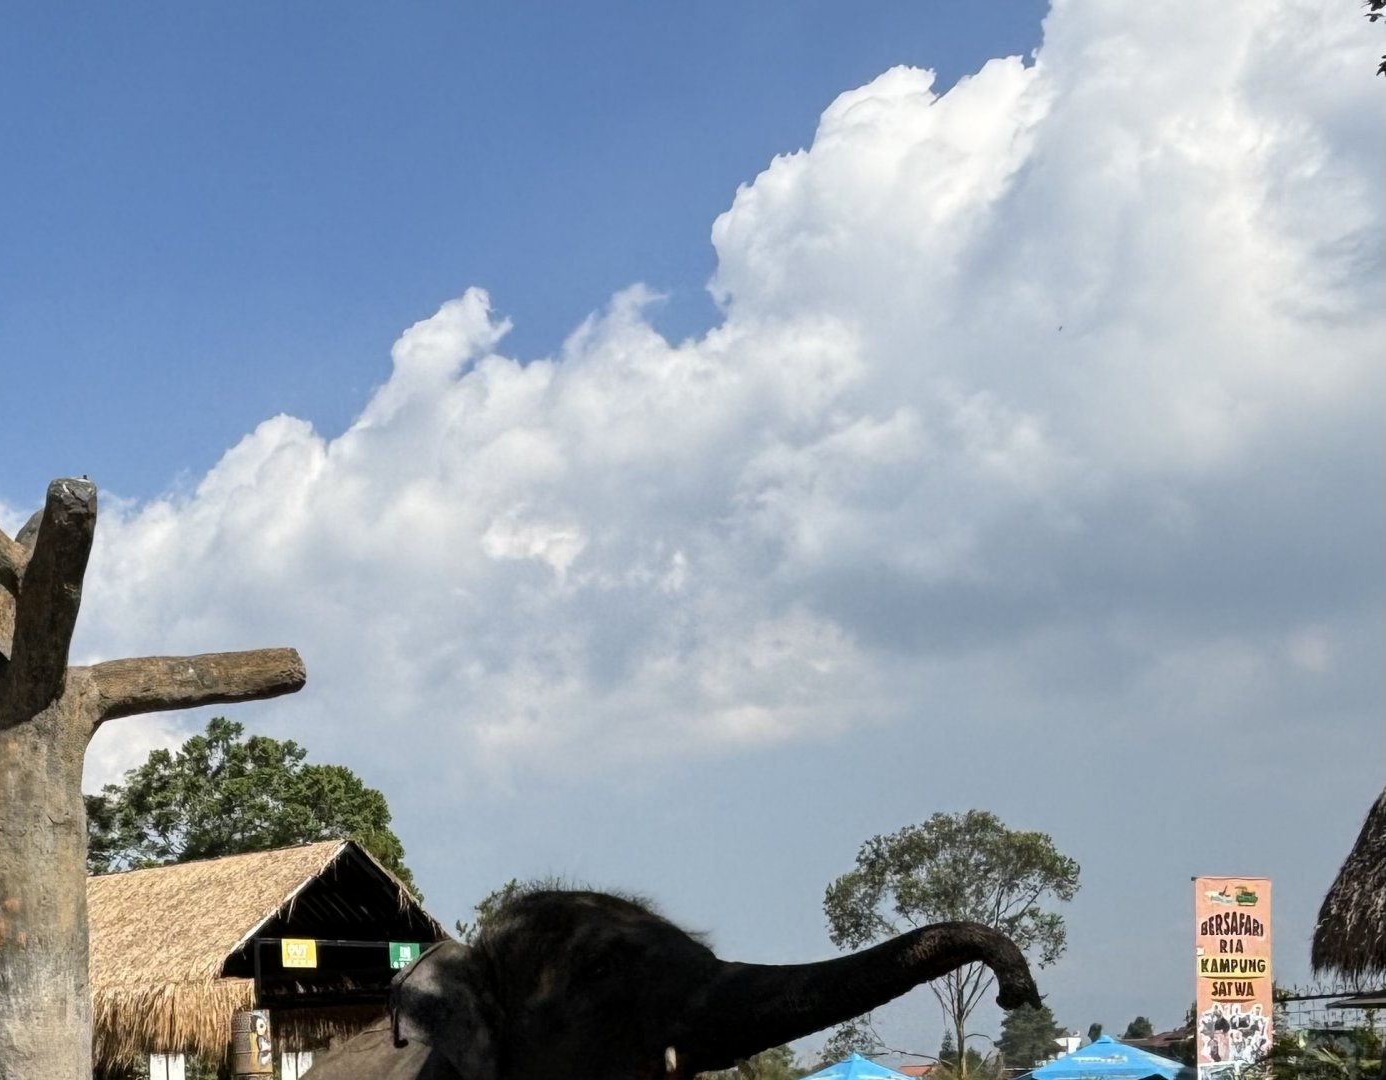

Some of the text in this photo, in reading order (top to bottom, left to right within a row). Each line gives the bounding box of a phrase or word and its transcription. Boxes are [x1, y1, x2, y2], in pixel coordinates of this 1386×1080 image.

[1201, 911, 1264, 937] BERSAFARI
[1219, 939, 1244, 954] RIA
[1200, 958, 1266, 973] KAMPUNG
[1211, 981, 1255, 997] SATWA
